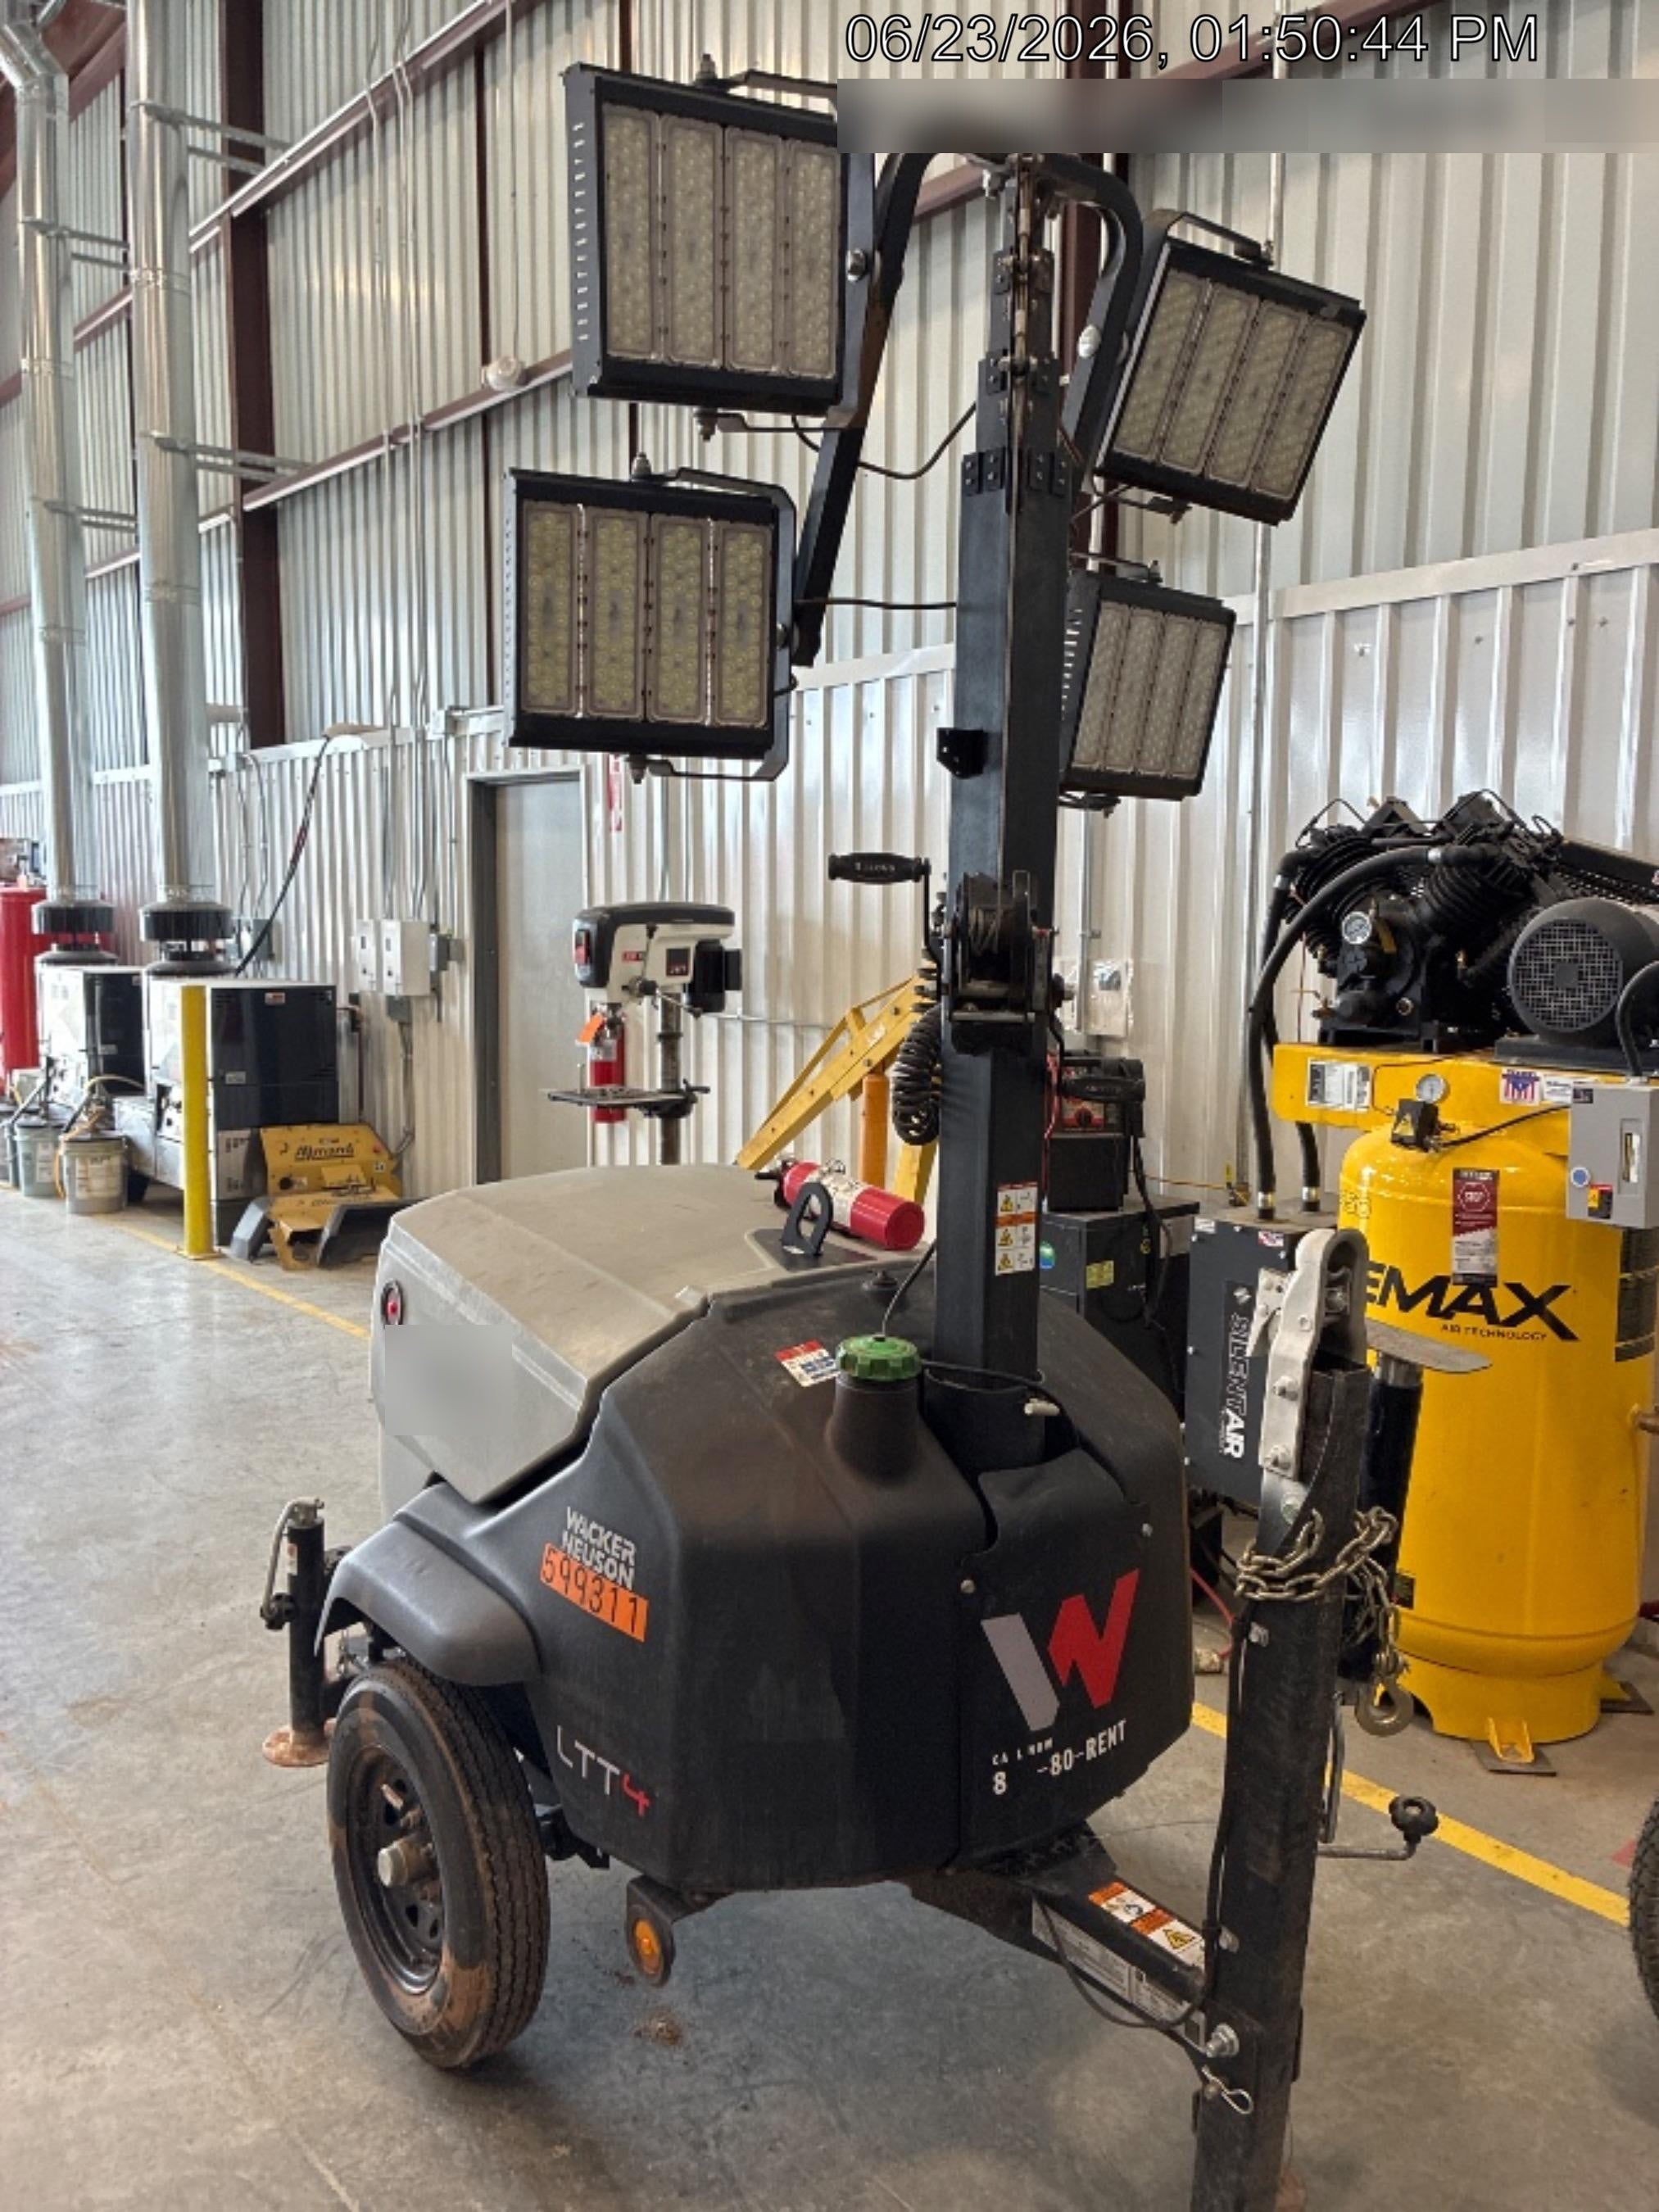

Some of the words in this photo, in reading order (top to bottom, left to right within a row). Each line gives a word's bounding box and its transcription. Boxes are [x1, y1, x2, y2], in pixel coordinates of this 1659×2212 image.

[1441, 1323, 1461, 1334] AIR
[1465, 1326, 1547, 1341] TECHNOLOGY
[561, 1530, 634, 1591] NEUSON
[566, 1506, 636, 1566] WACKER
[542, 1547, 637, 1634] 599311
[557, 1725, 650, 1817] LTT4
